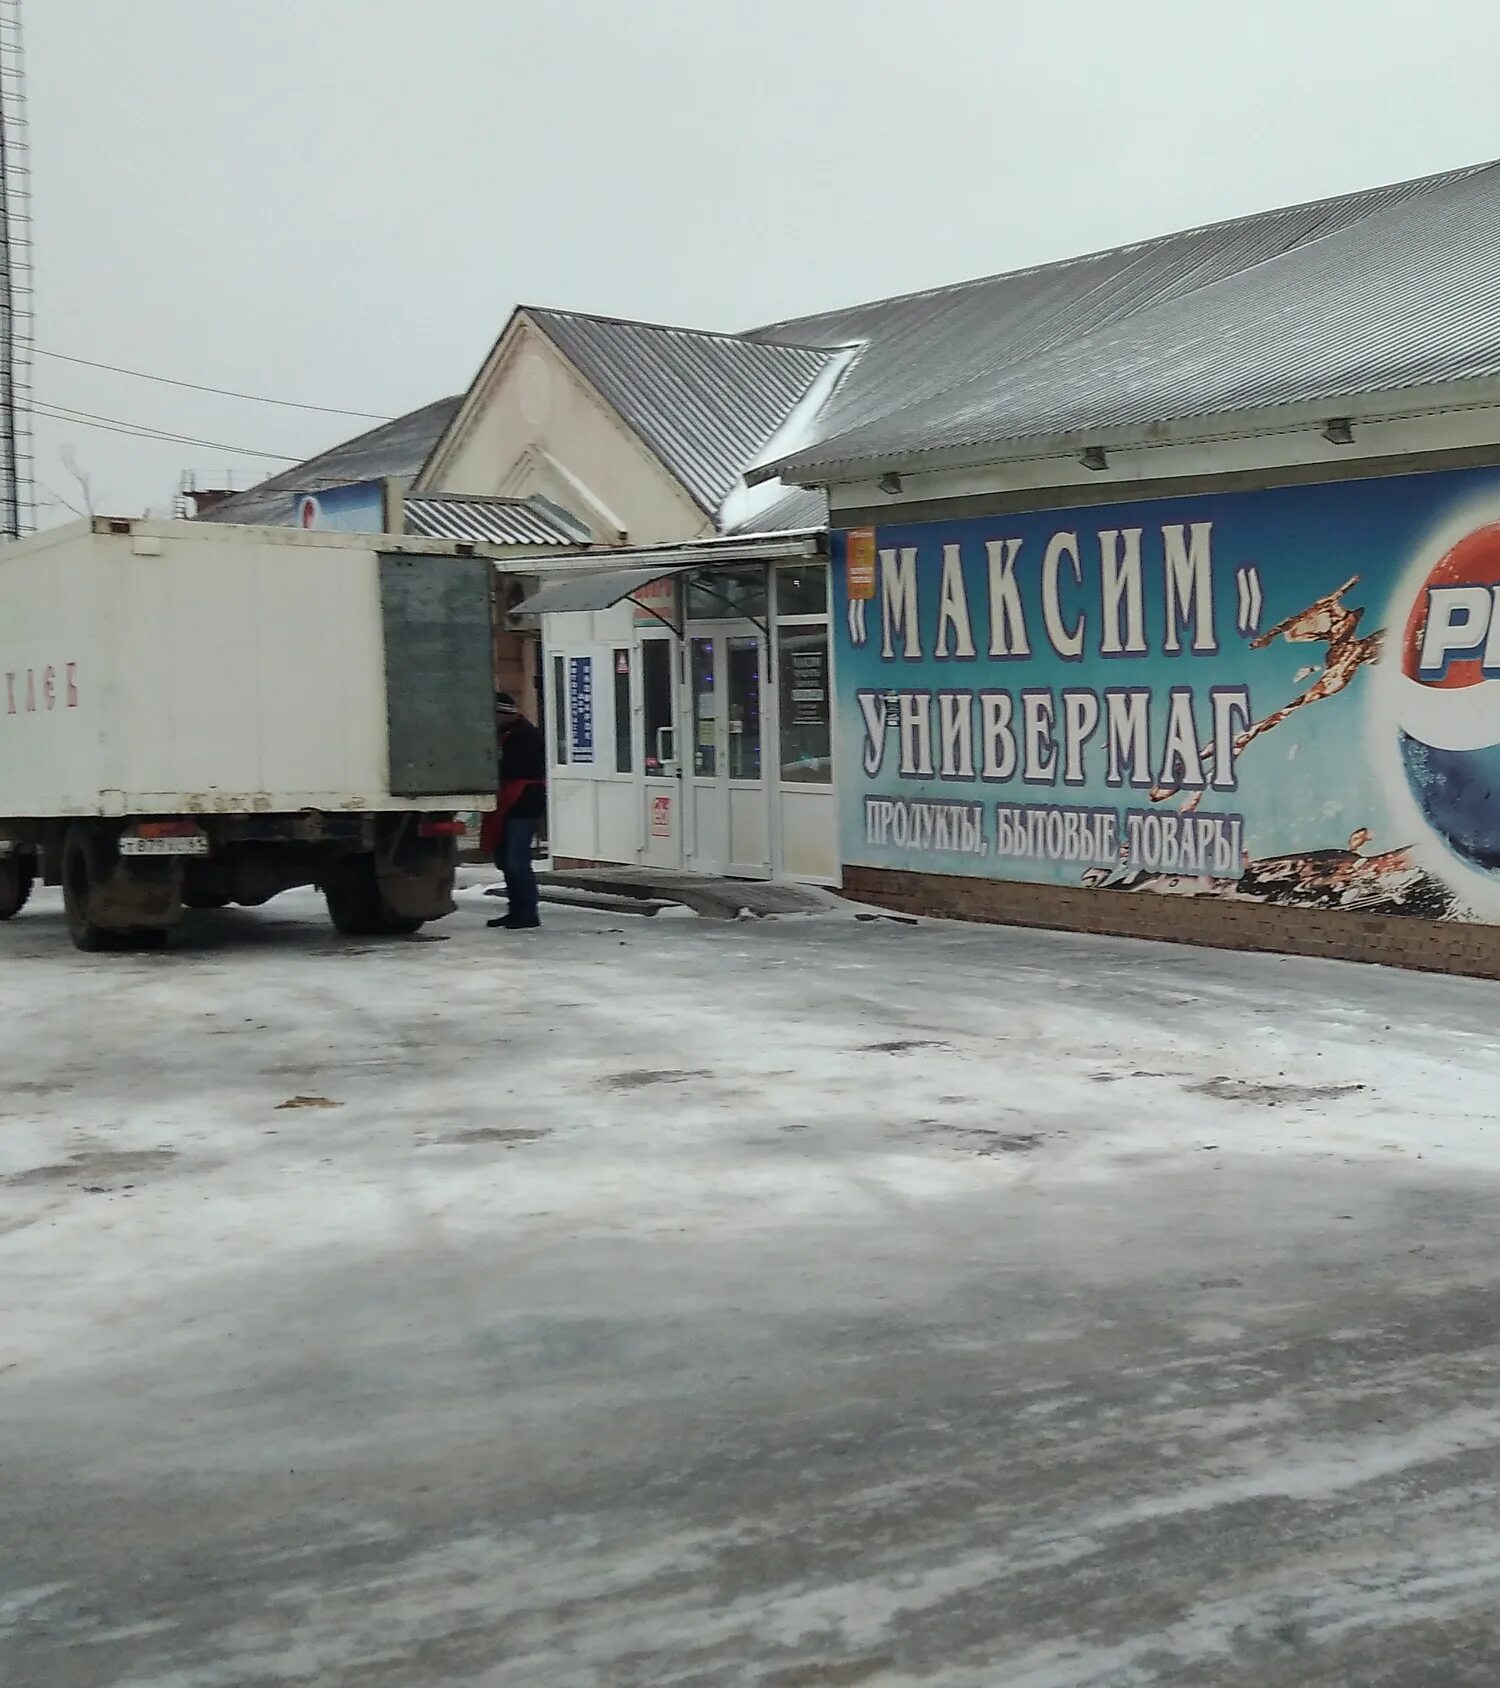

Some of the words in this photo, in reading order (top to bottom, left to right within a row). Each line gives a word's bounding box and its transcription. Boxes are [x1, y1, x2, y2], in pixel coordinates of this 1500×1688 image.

[847, 521, 1263, 662] «МАКСИМ»
[856, 684, 1252, 792] УНИВЕРМАГ
[865, 797, 988, 858] ПРОДУКТЫ,
[997, 805, 1119, 864] БЫТОВЫЕ
[1127, 811, 1245, 874] ТОВАРЫ
